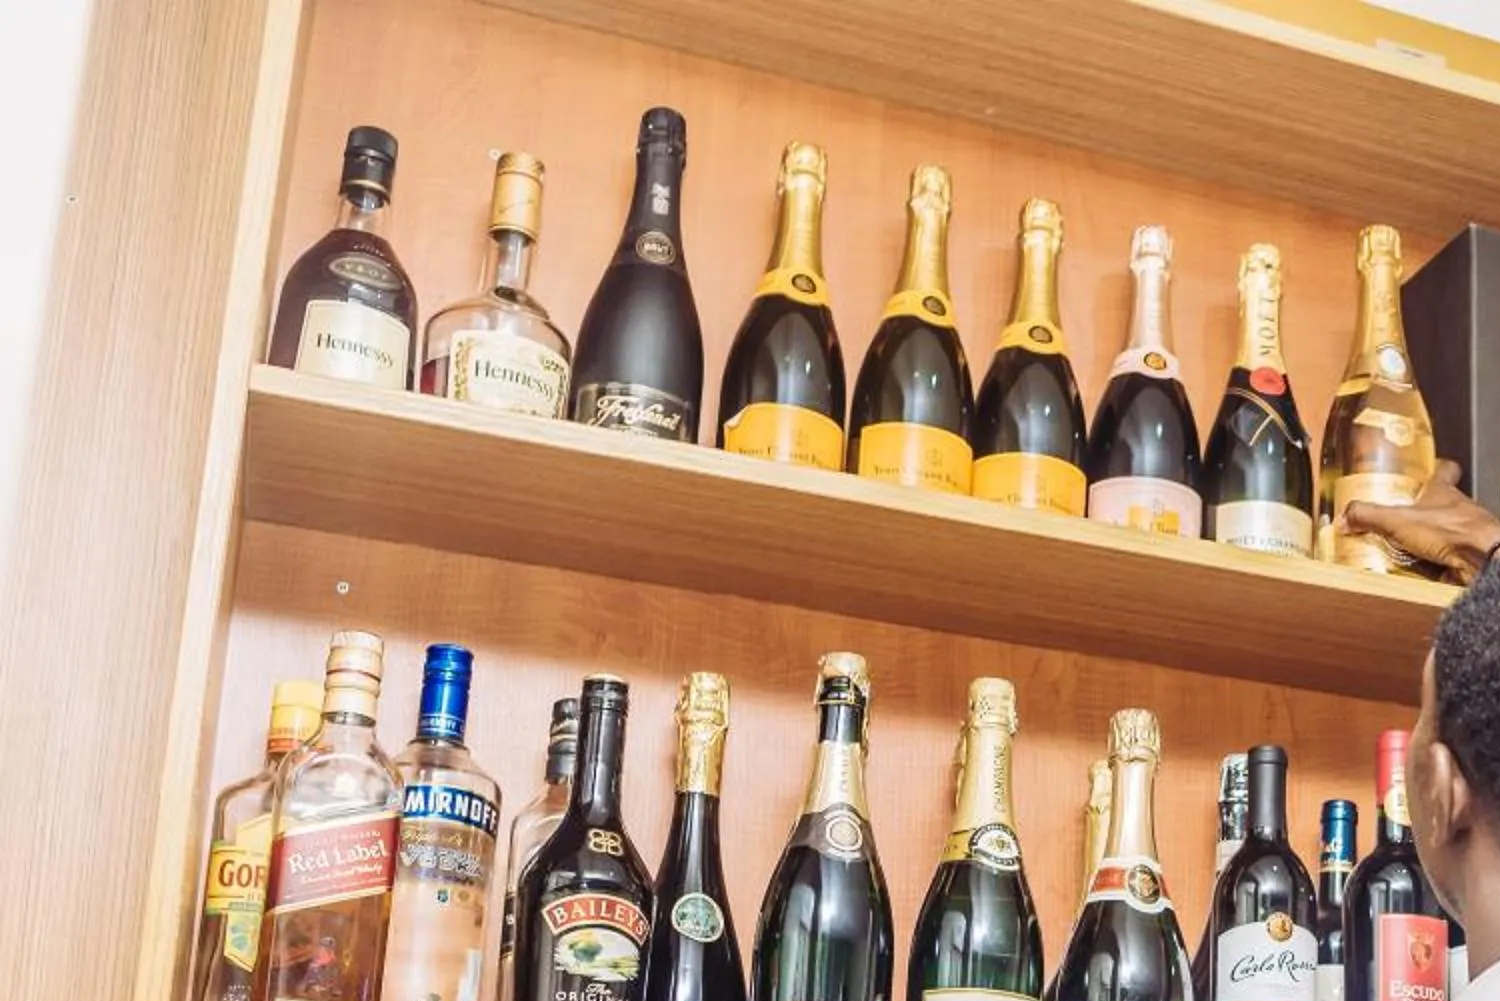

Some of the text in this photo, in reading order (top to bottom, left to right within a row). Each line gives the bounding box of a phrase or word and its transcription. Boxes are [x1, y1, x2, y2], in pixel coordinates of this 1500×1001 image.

[316, 332, 394, 370] Hennessy
[475, 359, 553, 402] Hennessy
[404, 787, 498, 833] MIRNOFF
[218, 859, 267, 889] GOR
[288, 849, 330, 875] Red
[331, 839, 389, 867] Label
[1229, 949, 1318, 983] Carlo Rossi
